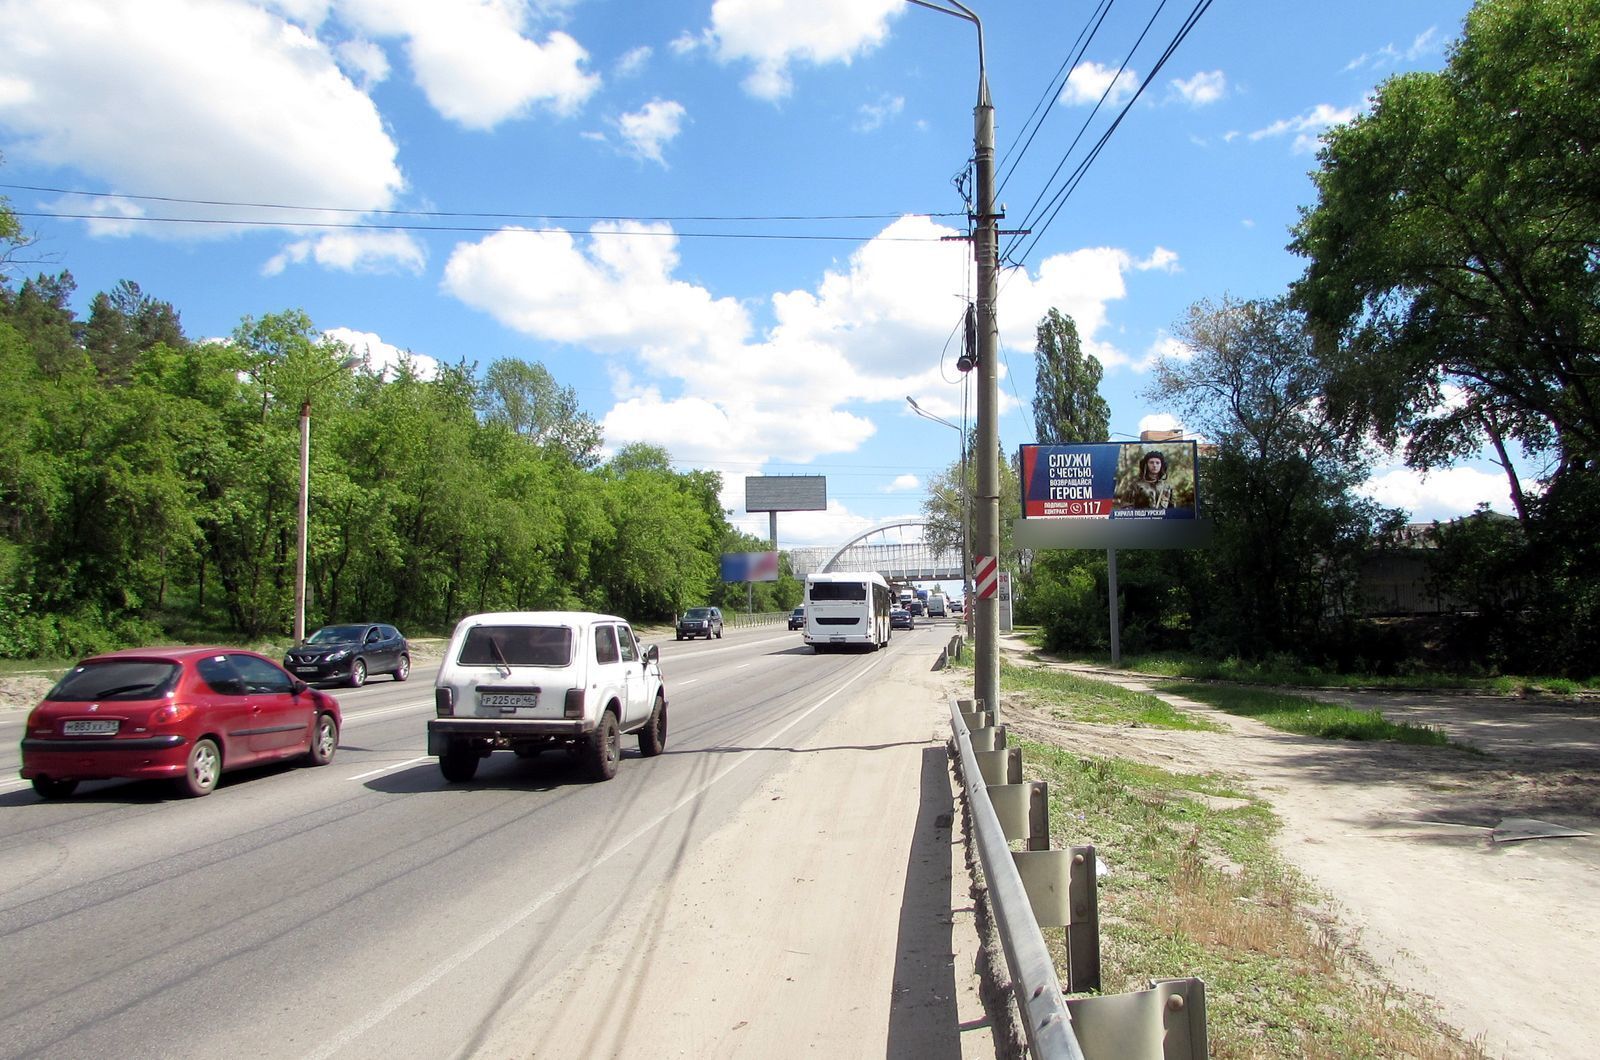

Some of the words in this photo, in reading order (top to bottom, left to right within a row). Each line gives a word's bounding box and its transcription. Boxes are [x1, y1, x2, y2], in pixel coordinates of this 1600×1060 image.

[1049, 453, 1091, 467] СЛУЖИ
[1049, 468, 1055, 478] С
[1057, 467, 1094, 479] ЧЕСТЬЮ,
[1050, 478, 1092, 487] ВОЗВРАЩАЙСЯ
[1050, 486, 1092, 500] ГЕРОЕМ
[1083, 501, 1101, 514] 117
